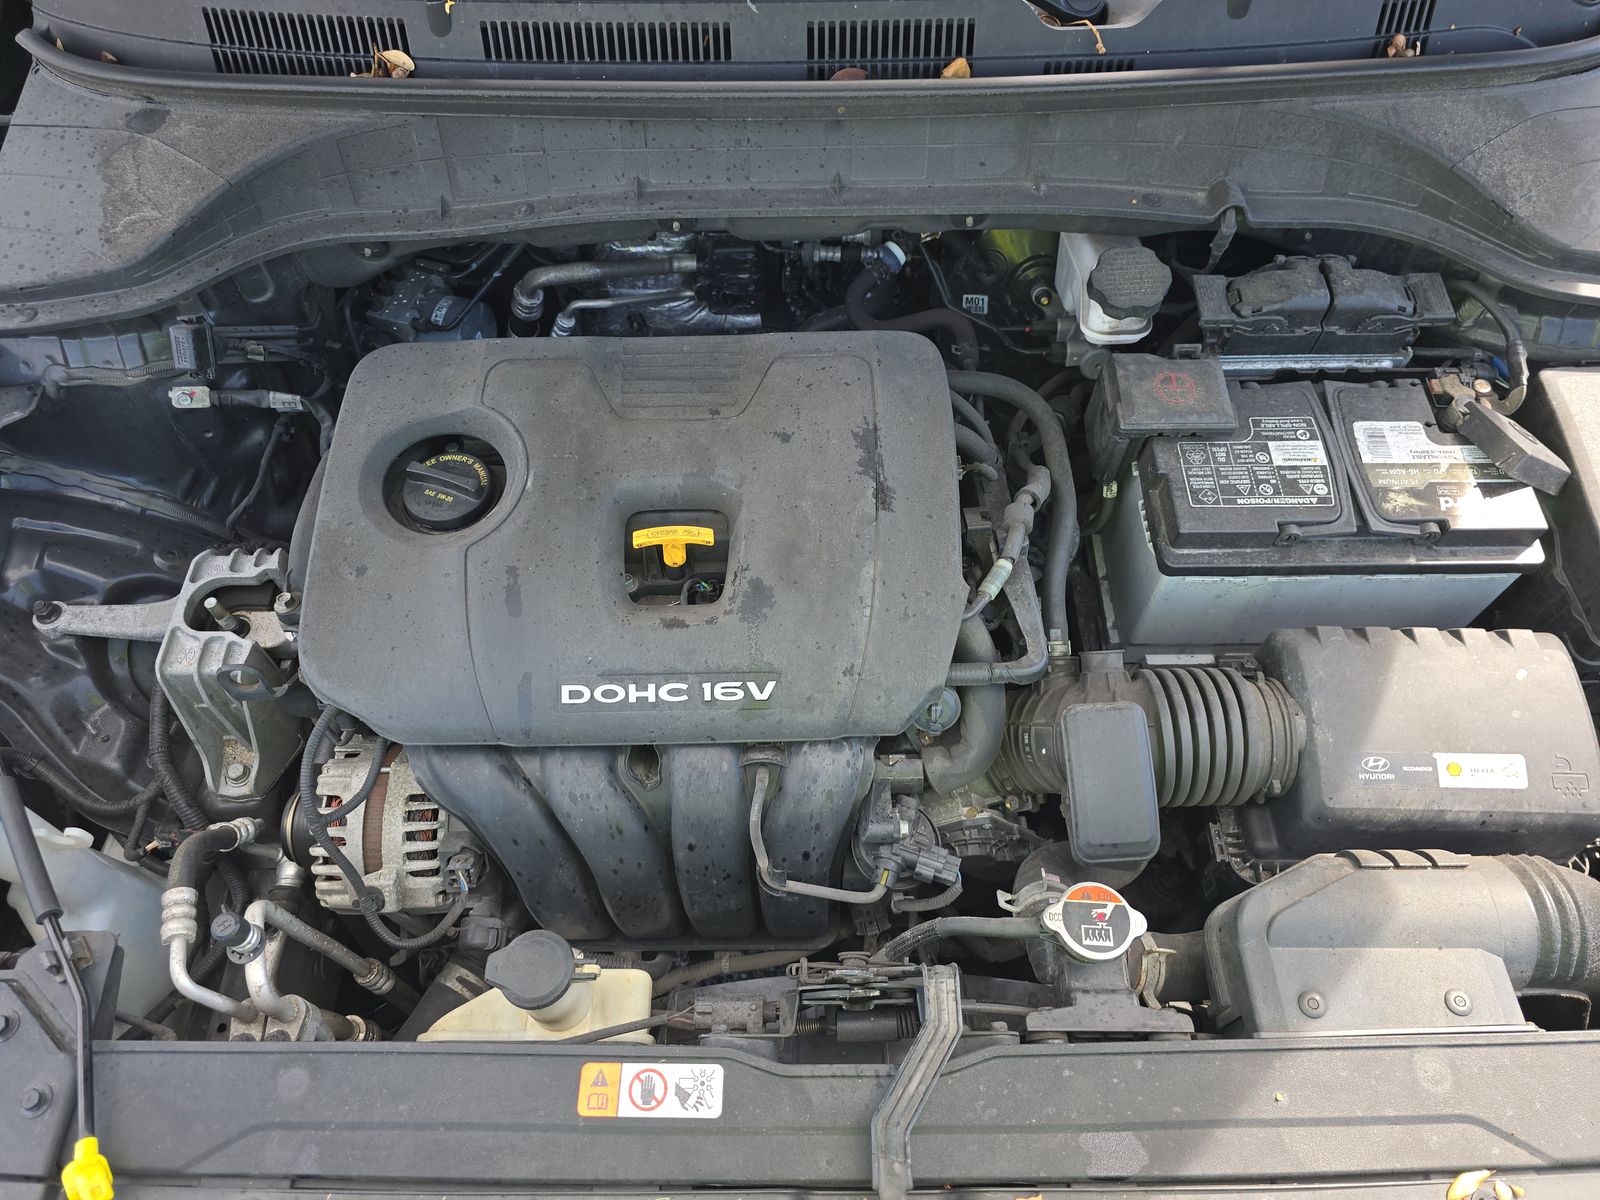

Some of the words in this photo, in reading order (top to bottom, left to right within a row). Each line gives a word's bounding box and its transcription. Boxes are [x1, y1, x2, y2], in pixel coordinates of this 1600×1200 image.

[965, 296, 985, 306] M01
[439, 455, 474, 464] OWNER'S
[473, 463, 488, 486] MANUAL
[561, 683, 689, 704] DOHC
[702, 680, 777, 702] 16V
[1048, 912, 1062, 922] DCC
